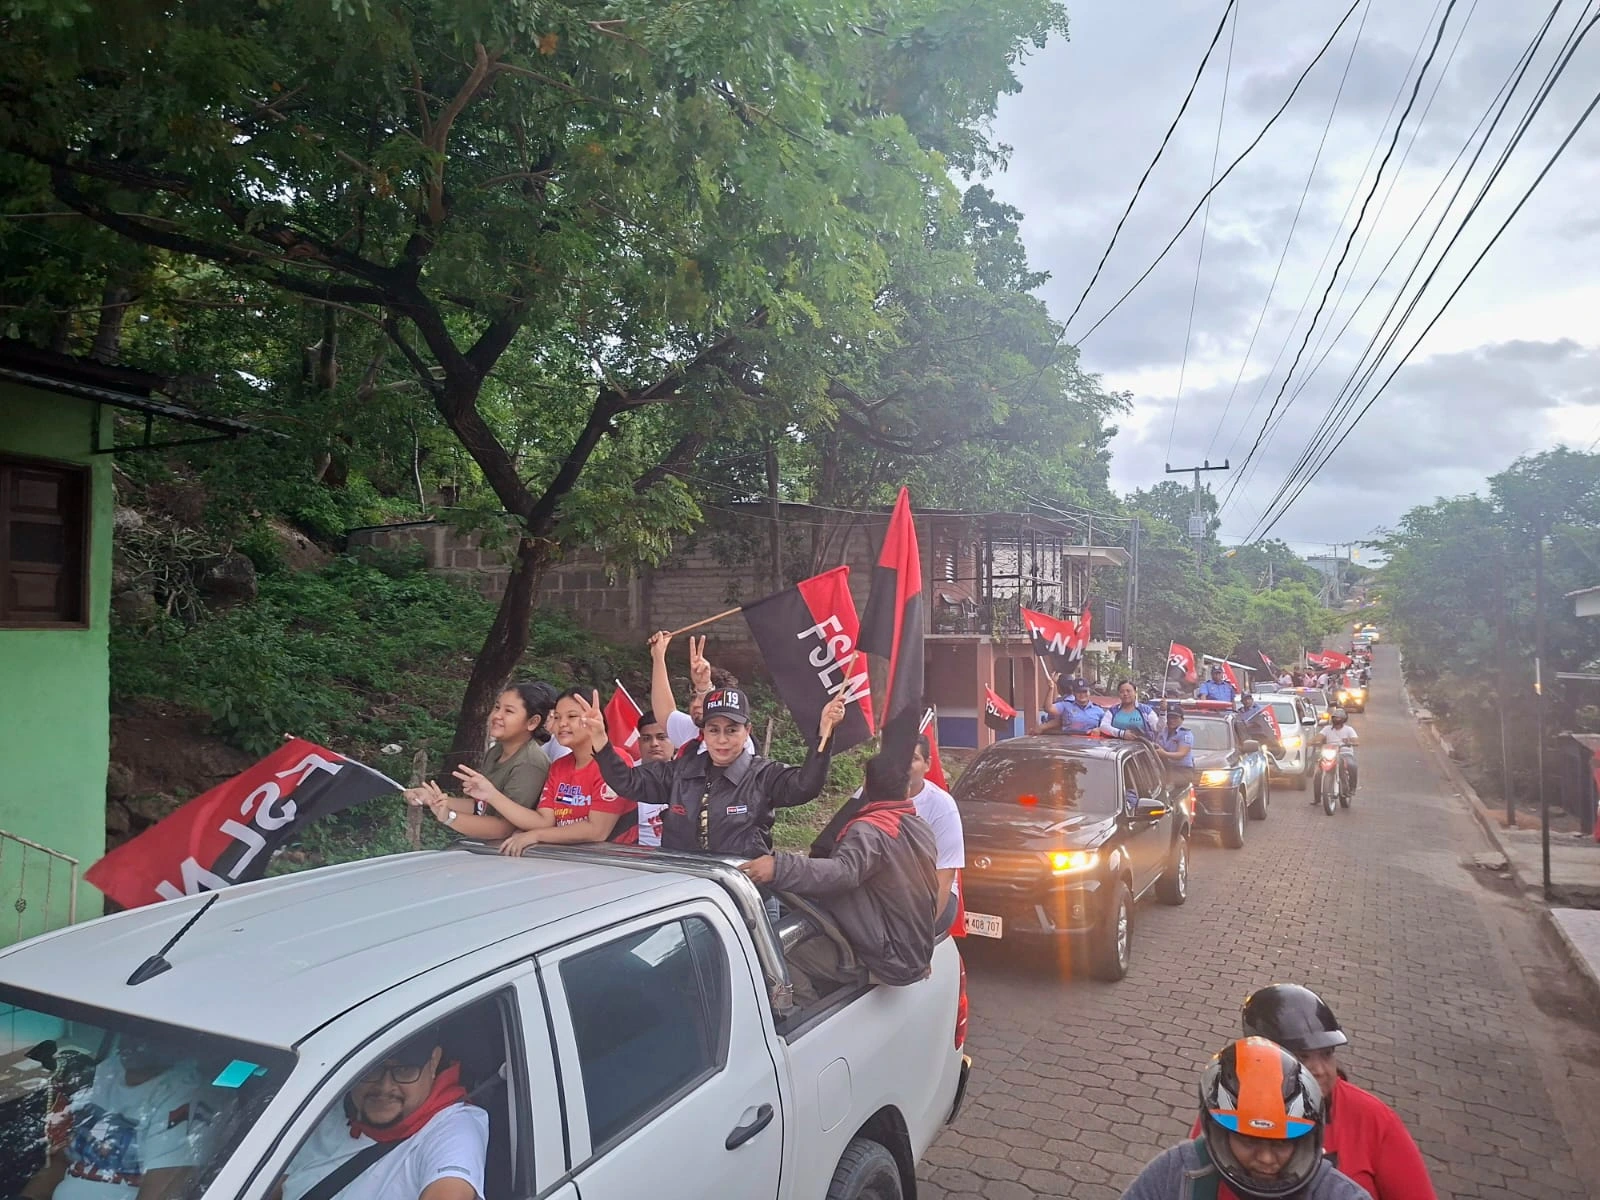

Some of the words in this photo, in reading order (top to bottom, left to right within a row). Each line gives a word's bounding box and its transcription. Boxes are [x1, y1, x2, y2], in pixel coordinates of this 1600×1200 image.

[797, 614, 871, 705] FSLN
[707, 699, 723, 710] FSLN
[727, 691, 739, 705] 19
[971, 919, 984, 930] 408
[987, 920, 1000, 932] 707
